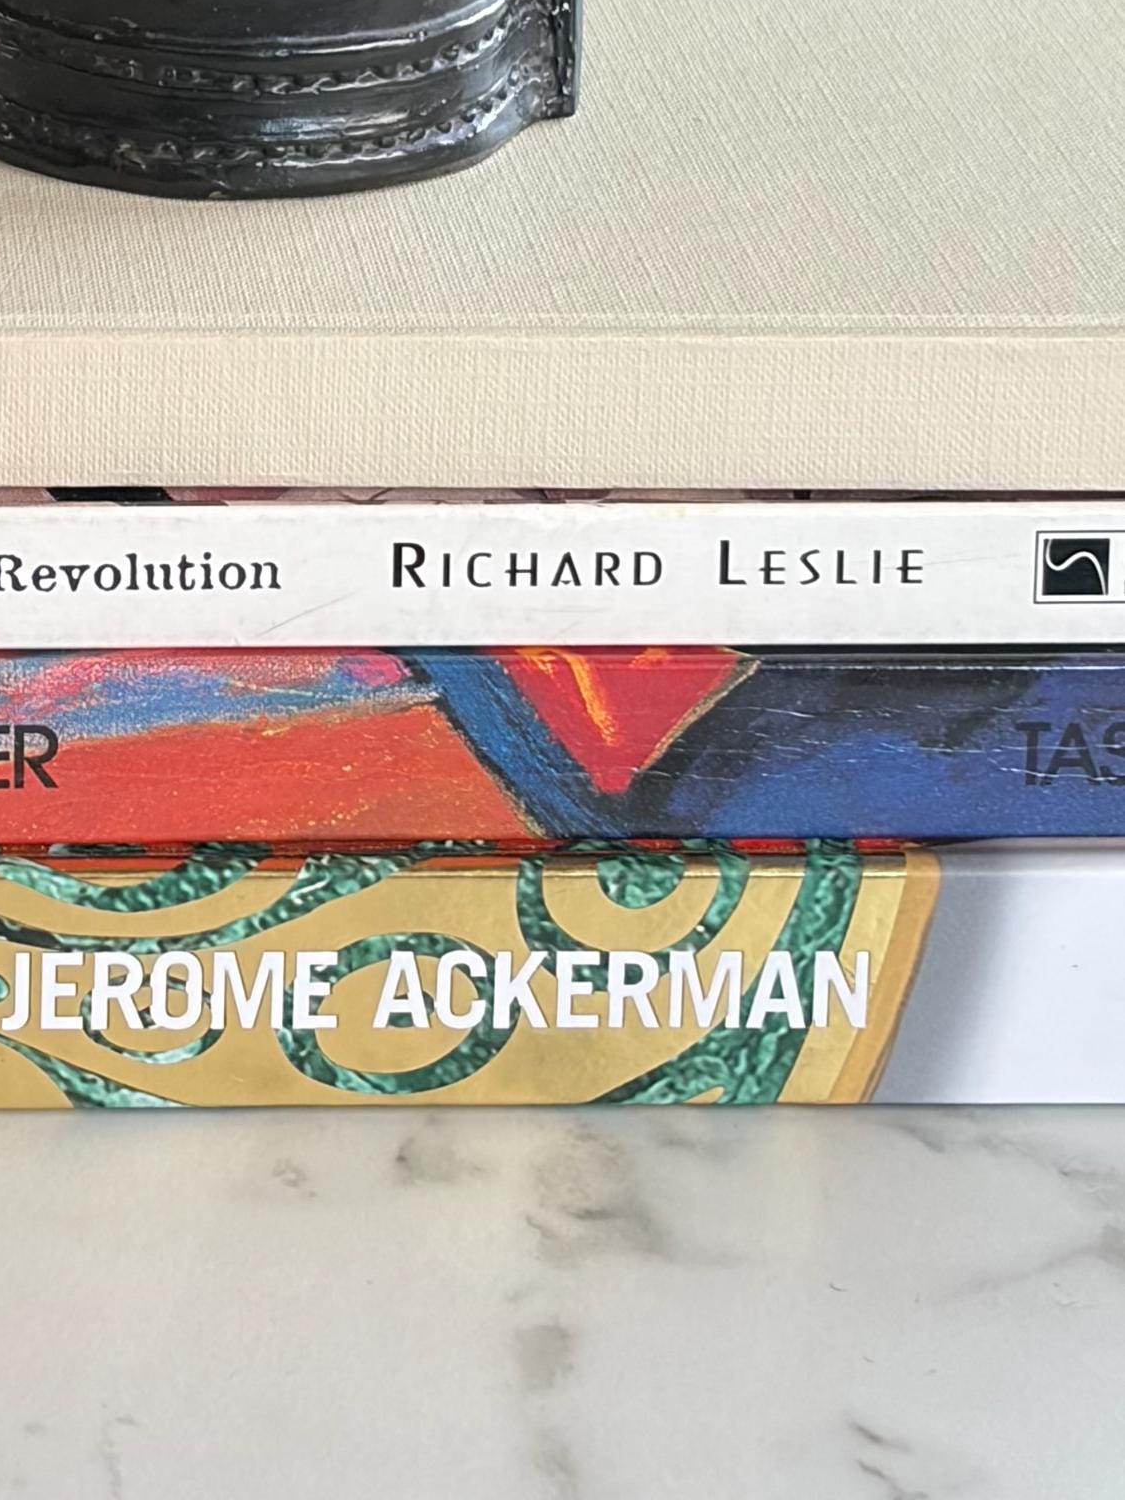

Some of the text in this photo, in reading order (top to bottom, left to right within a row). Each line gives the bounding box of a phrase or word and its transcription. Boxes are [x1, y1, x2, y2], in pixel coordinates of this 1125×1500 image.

[391, 540, 925, 589] RICHARD LESLIE
[1, 950, 338, 1031] JEROME
[372, 949, 871, 1031] ACKERMAN
